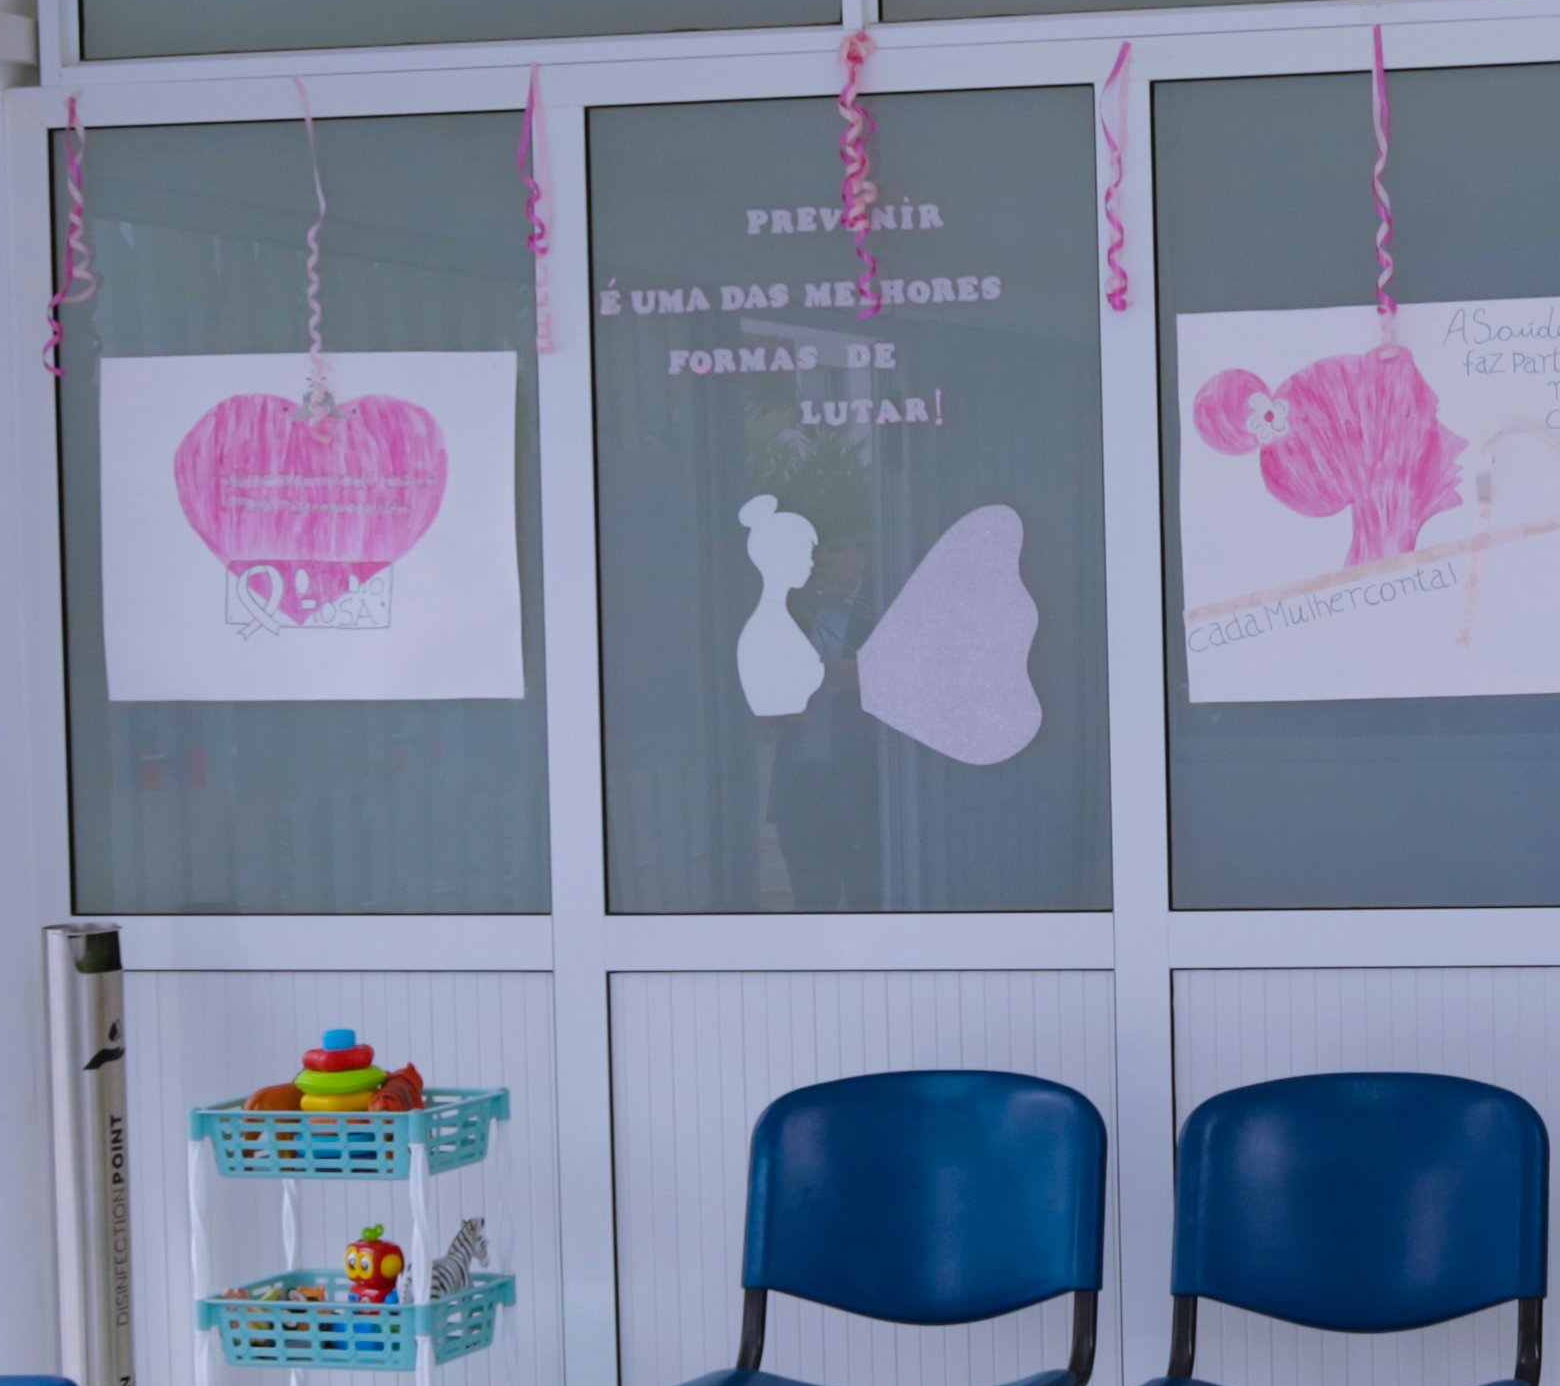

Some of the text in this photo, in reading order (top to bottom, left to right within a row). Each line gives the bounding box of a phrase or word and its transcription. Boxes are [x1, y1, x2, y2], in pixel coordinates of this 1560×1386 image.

[746, 196, 944, 235] PREVNIR
[598, 276, 1003, 315] É UMA DAS MEHORES
[1442, 307, 1468, 346] A
[668, 342, 897, 375] FORMAS DE
[1462, 349, 1506, 376] faz
[799, 388, 944, 426] LUTAR!
